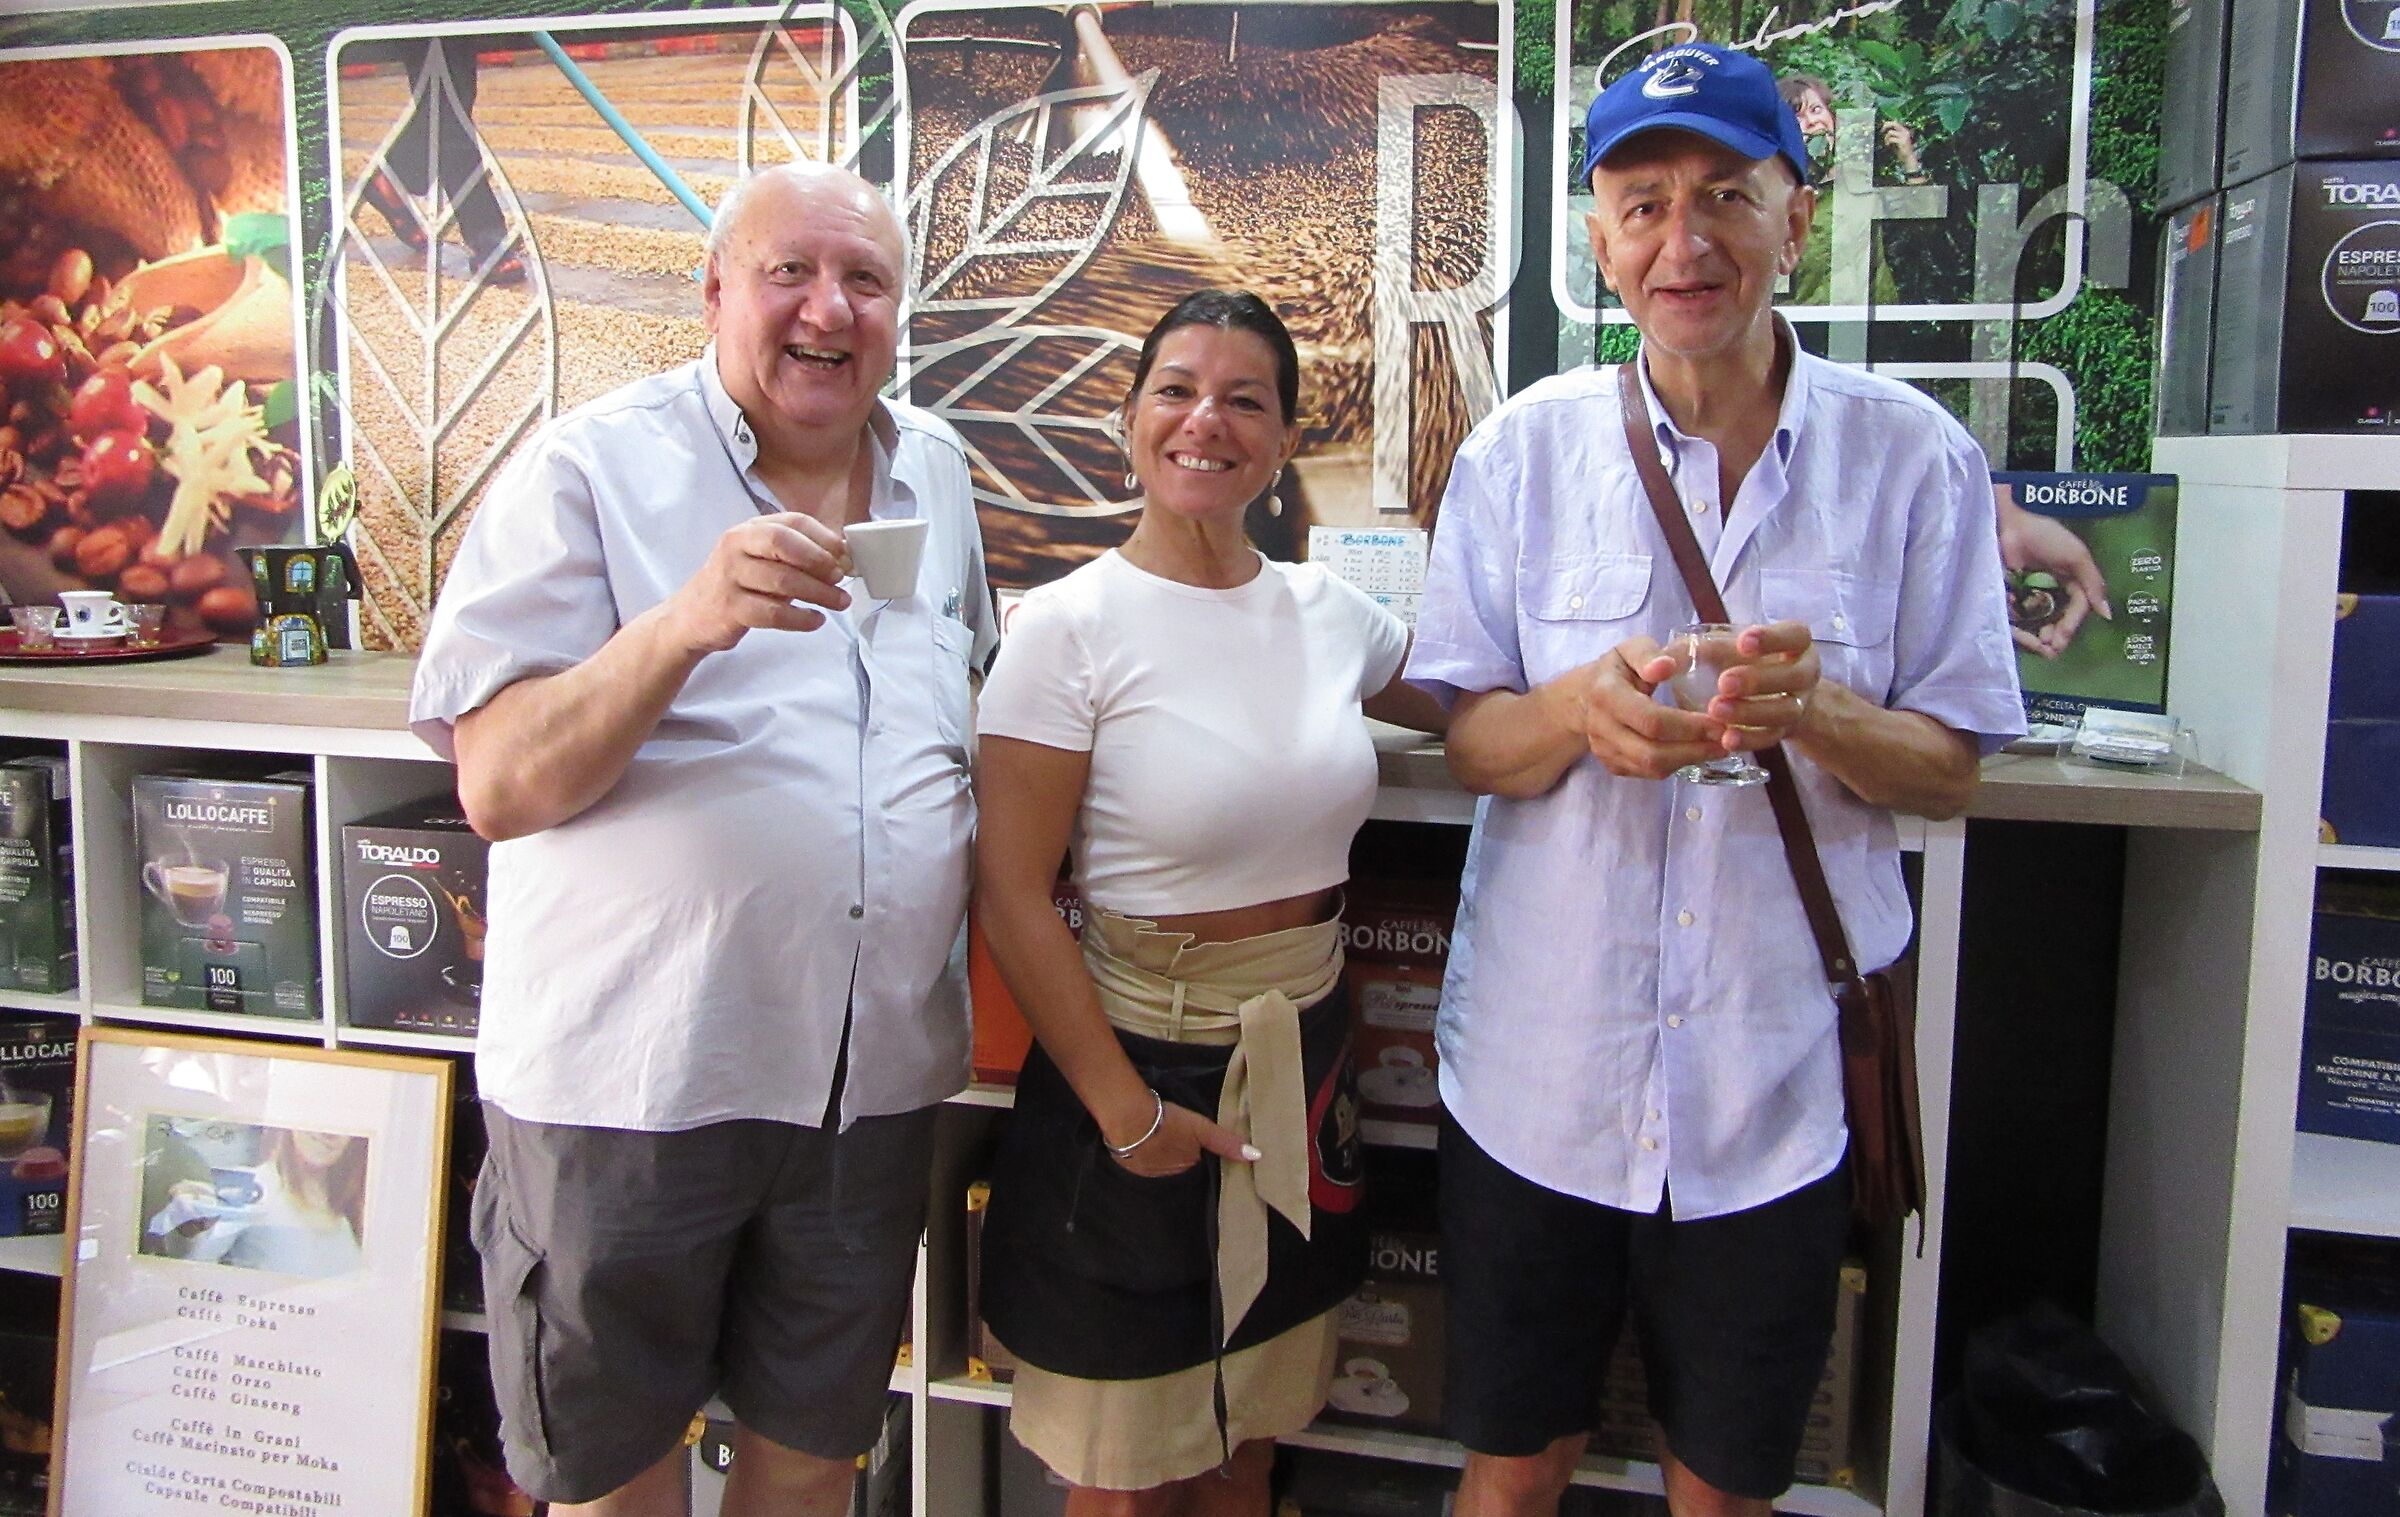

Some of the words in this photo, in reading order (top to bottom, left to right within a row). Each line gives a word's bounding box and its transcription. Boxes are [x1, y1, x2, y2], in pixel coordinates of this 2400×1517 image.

[1639, 48, 1719, 72] VANCOUVER
[2370, 302, 2396, 313] 100
[2025, 484, 2128, 506] BORBONE
[2130, 556, 2161, 567] ZERO
[2128, 605, 2160, 613] CARTA
[241, 856, 286, 868] ESPRESSO
[358, 844, 440, 864] TORALDO
[254, 878, 297, 888] CAPSULA
[371, 894, 428, 909] ESPRESSO
[210, 967, 236, 986] 100
[28, 1193, 59, 1209] 100
[179, 1286, 223, 1303] Caffè
[238, 1294, 316, 1316] Espresso
[174, 1346, 220, 1363] Caffè
[233, 1354, 322, 1378] Macchiato
[232, 1373, 271, 1390] Orzo
[171, 1384, 216, 1401] Caffè
[230, 1392, 301, 1417] Ginseng
[171, 1418, 214, 1436] Caffè
[254, 1430, 301, 1449] Grani
[132, 1428, 174, 1446] Caffè
[181, 1436, 256, 1459] Macinato
[262, 1450, 289, 1464] per
[296, 1453, 339, 1472] Moka
[182, 1470, 226, 1489] Carta
[232, 1478, 341, 1507] Compostabili
[146, 1481, 209, 1503] Capsule
[220, 1494, 317, 1517] Compatibili
